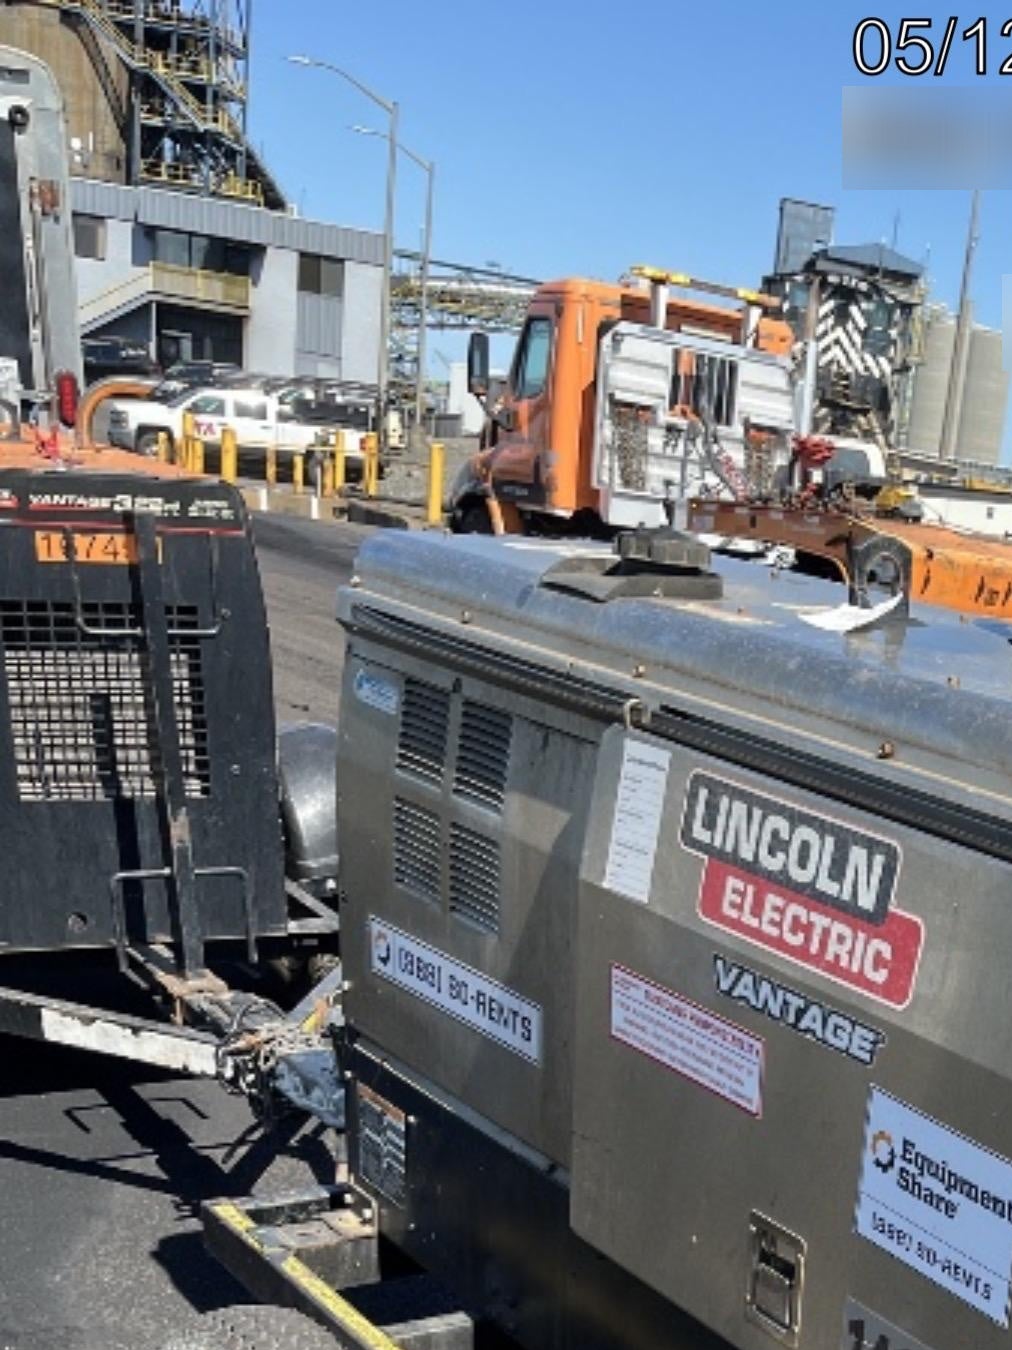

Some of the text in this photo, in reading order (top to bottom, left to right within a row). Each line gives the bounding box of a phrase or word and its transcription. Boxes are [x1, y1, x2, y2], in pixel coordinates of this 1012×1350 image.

[691, 787, 886, 913] LINCOLN
[721, 875, 893, 985] ELECTRIC
[715, 954, 878, 1064] VANTAGE
[896, 1166, 959, 1220] Share
